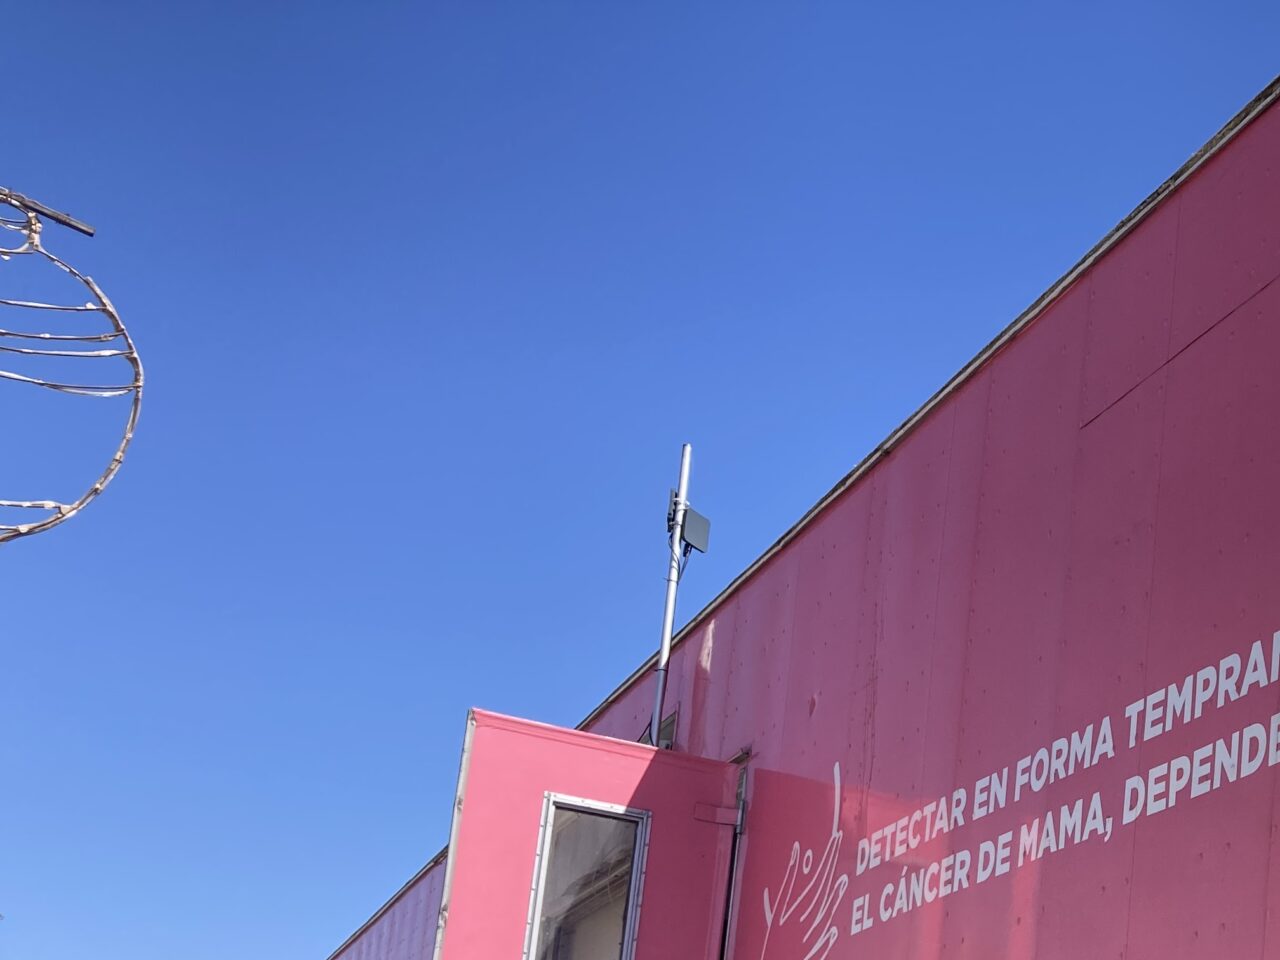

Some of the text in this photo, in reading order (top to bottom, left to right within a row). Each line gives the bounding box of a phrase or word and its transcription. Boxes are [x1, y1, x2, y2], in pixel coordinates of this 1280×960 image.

[851, 893, 873, 935] EL
[879, 850, 970, 922] CÁNCER
[976, 831, 1012, 883] DE
[1017, 791, 1113, 868] MAMA,
[856, 788, 967, 876] DETECTAR
[972, 766, 1009, 821] EN
[1014, 716, 1114, 802] FORMA
